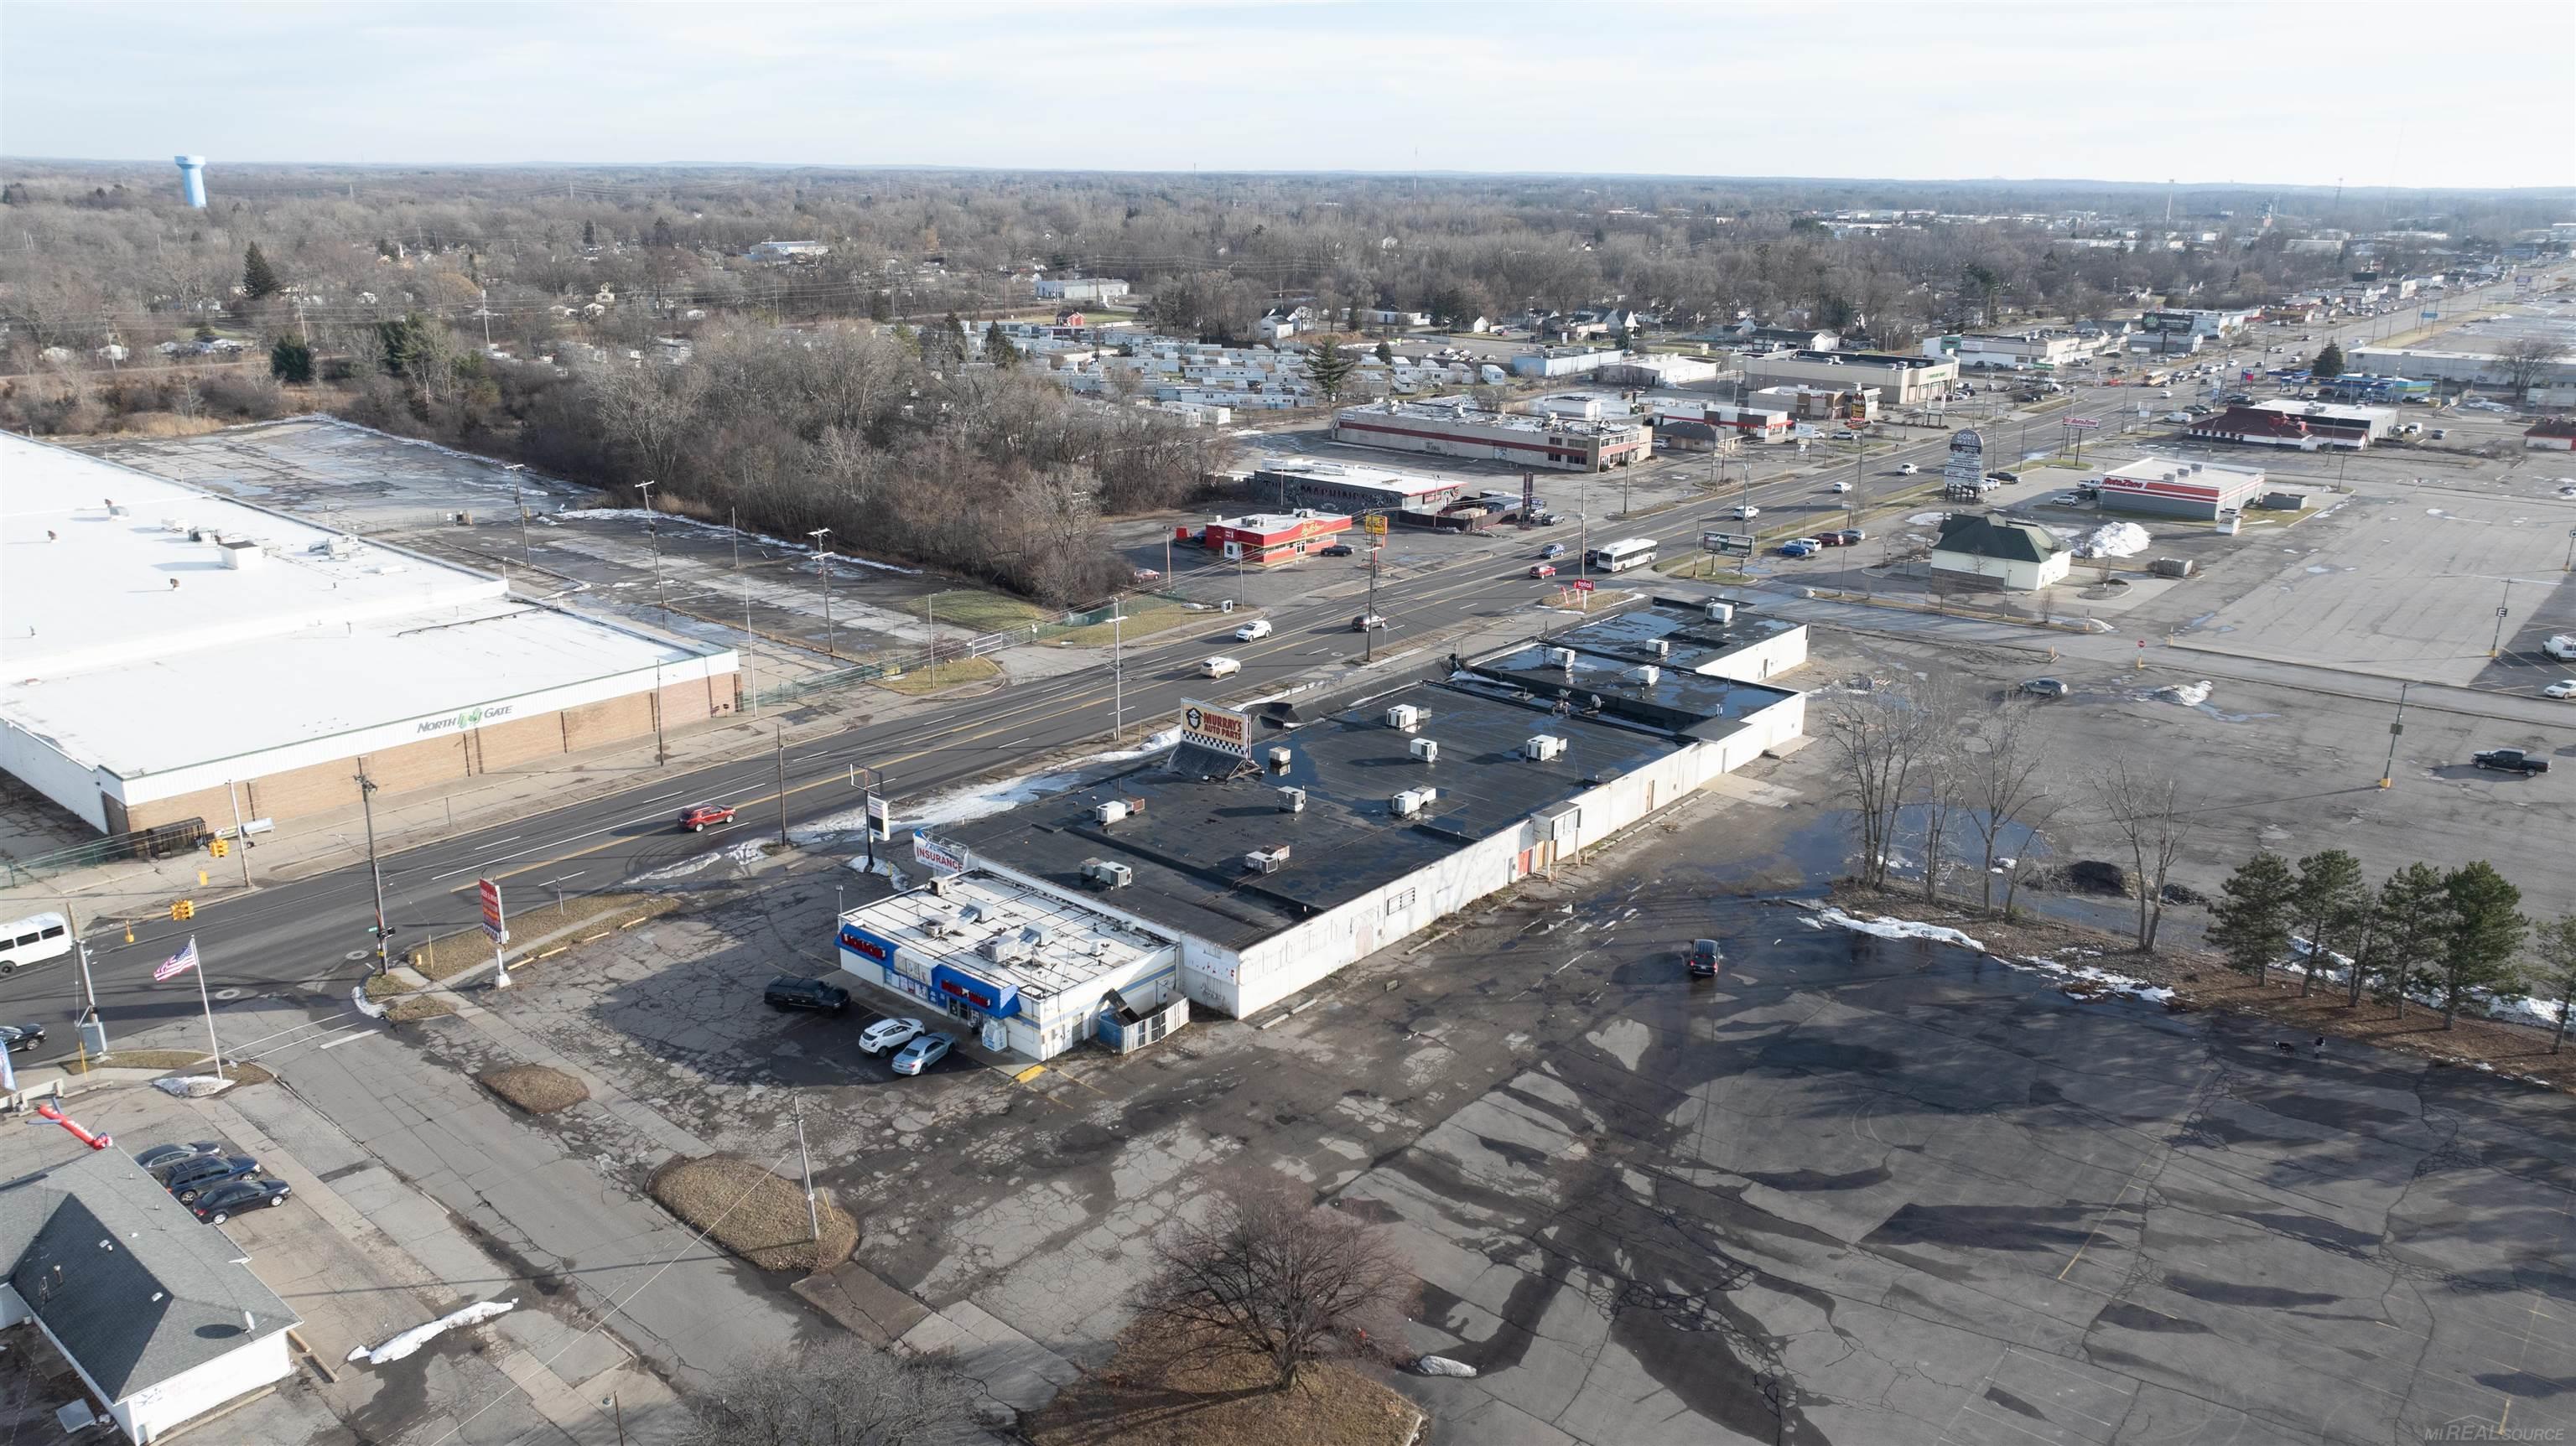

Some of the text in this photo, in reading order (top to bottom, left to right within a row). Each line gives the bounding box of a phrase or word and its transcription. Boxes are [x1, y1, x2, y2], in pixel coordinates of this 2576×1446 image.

[2102, 477, 2143, 489] AutoZone
[2498, 609, 2506, 617] E
[417, 706, 512, 733] NORTH GATE
[1203, 712, 1242, 732] MURRAY'S
[1203, 723, 1242, 740] AUTO PARTS
[917, 846, 963, 873] INSURANCE
